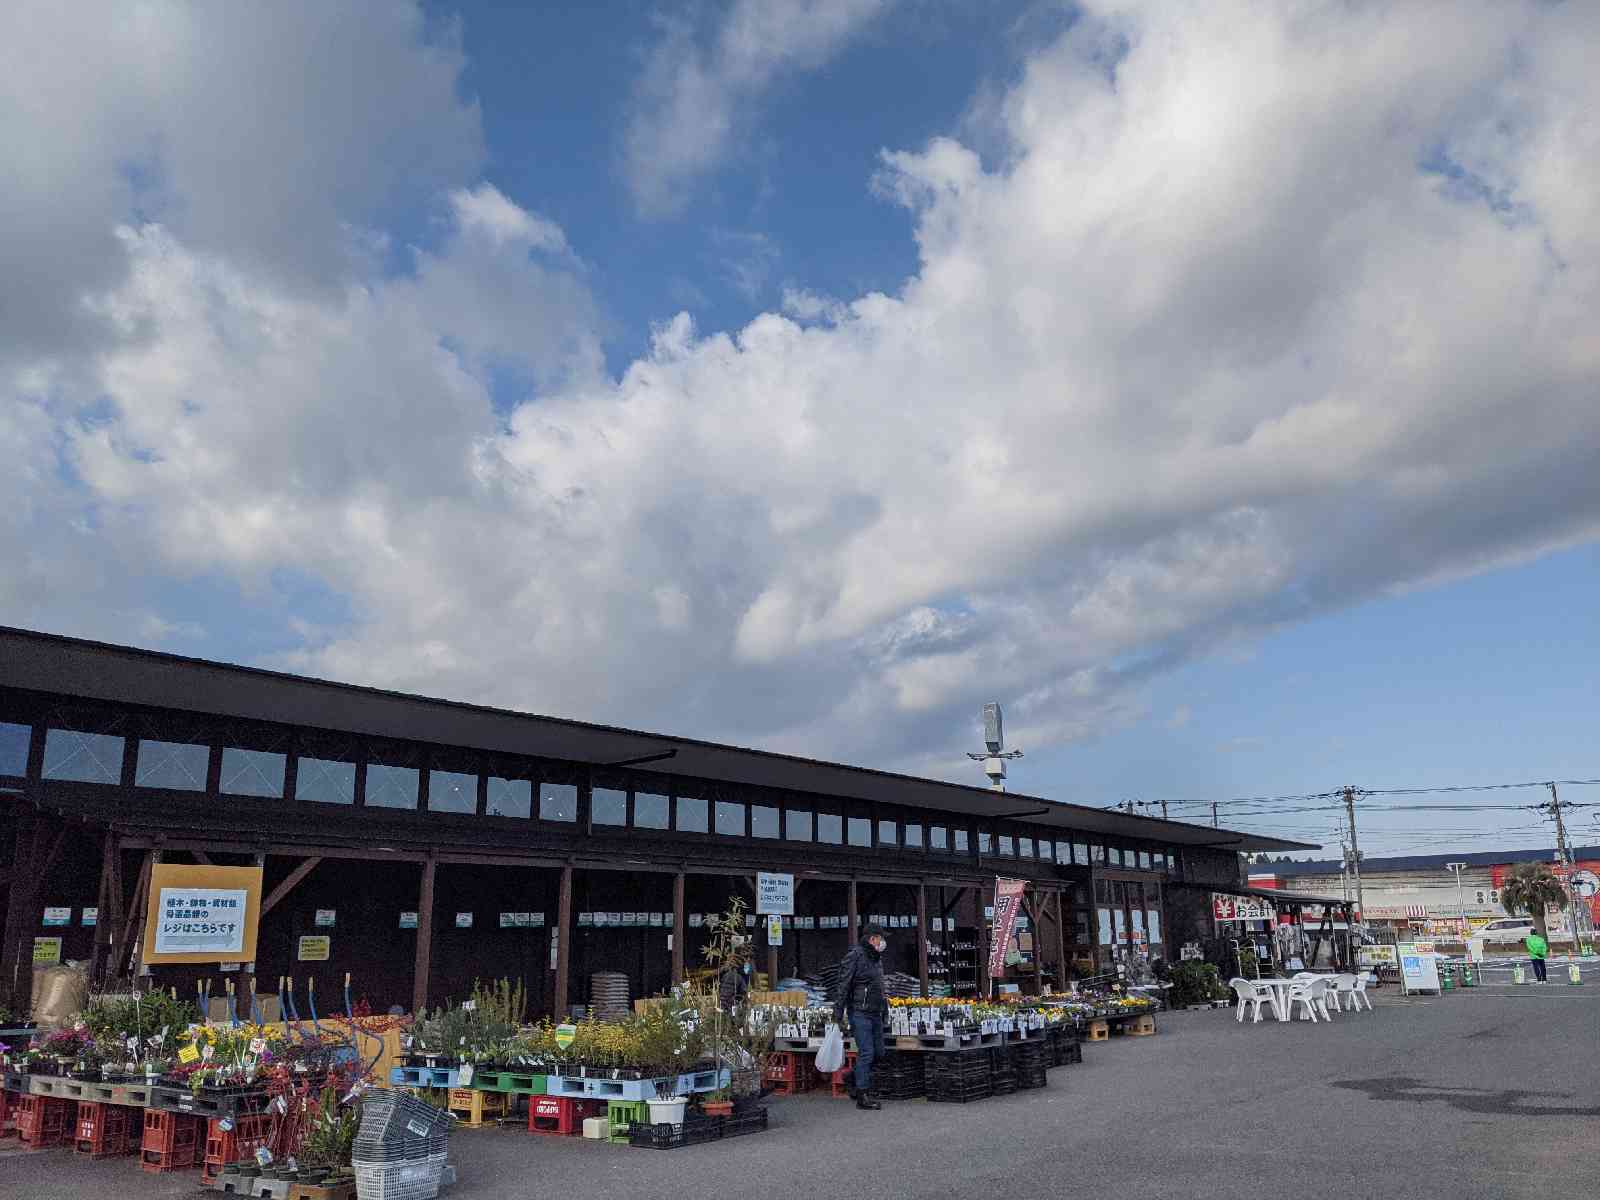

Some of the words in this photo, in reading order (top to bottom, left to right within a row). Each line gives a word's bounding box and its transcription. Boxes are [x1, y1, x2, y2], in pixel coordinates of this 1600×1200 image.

[163, 923, 236, 933] レジはこちらです
